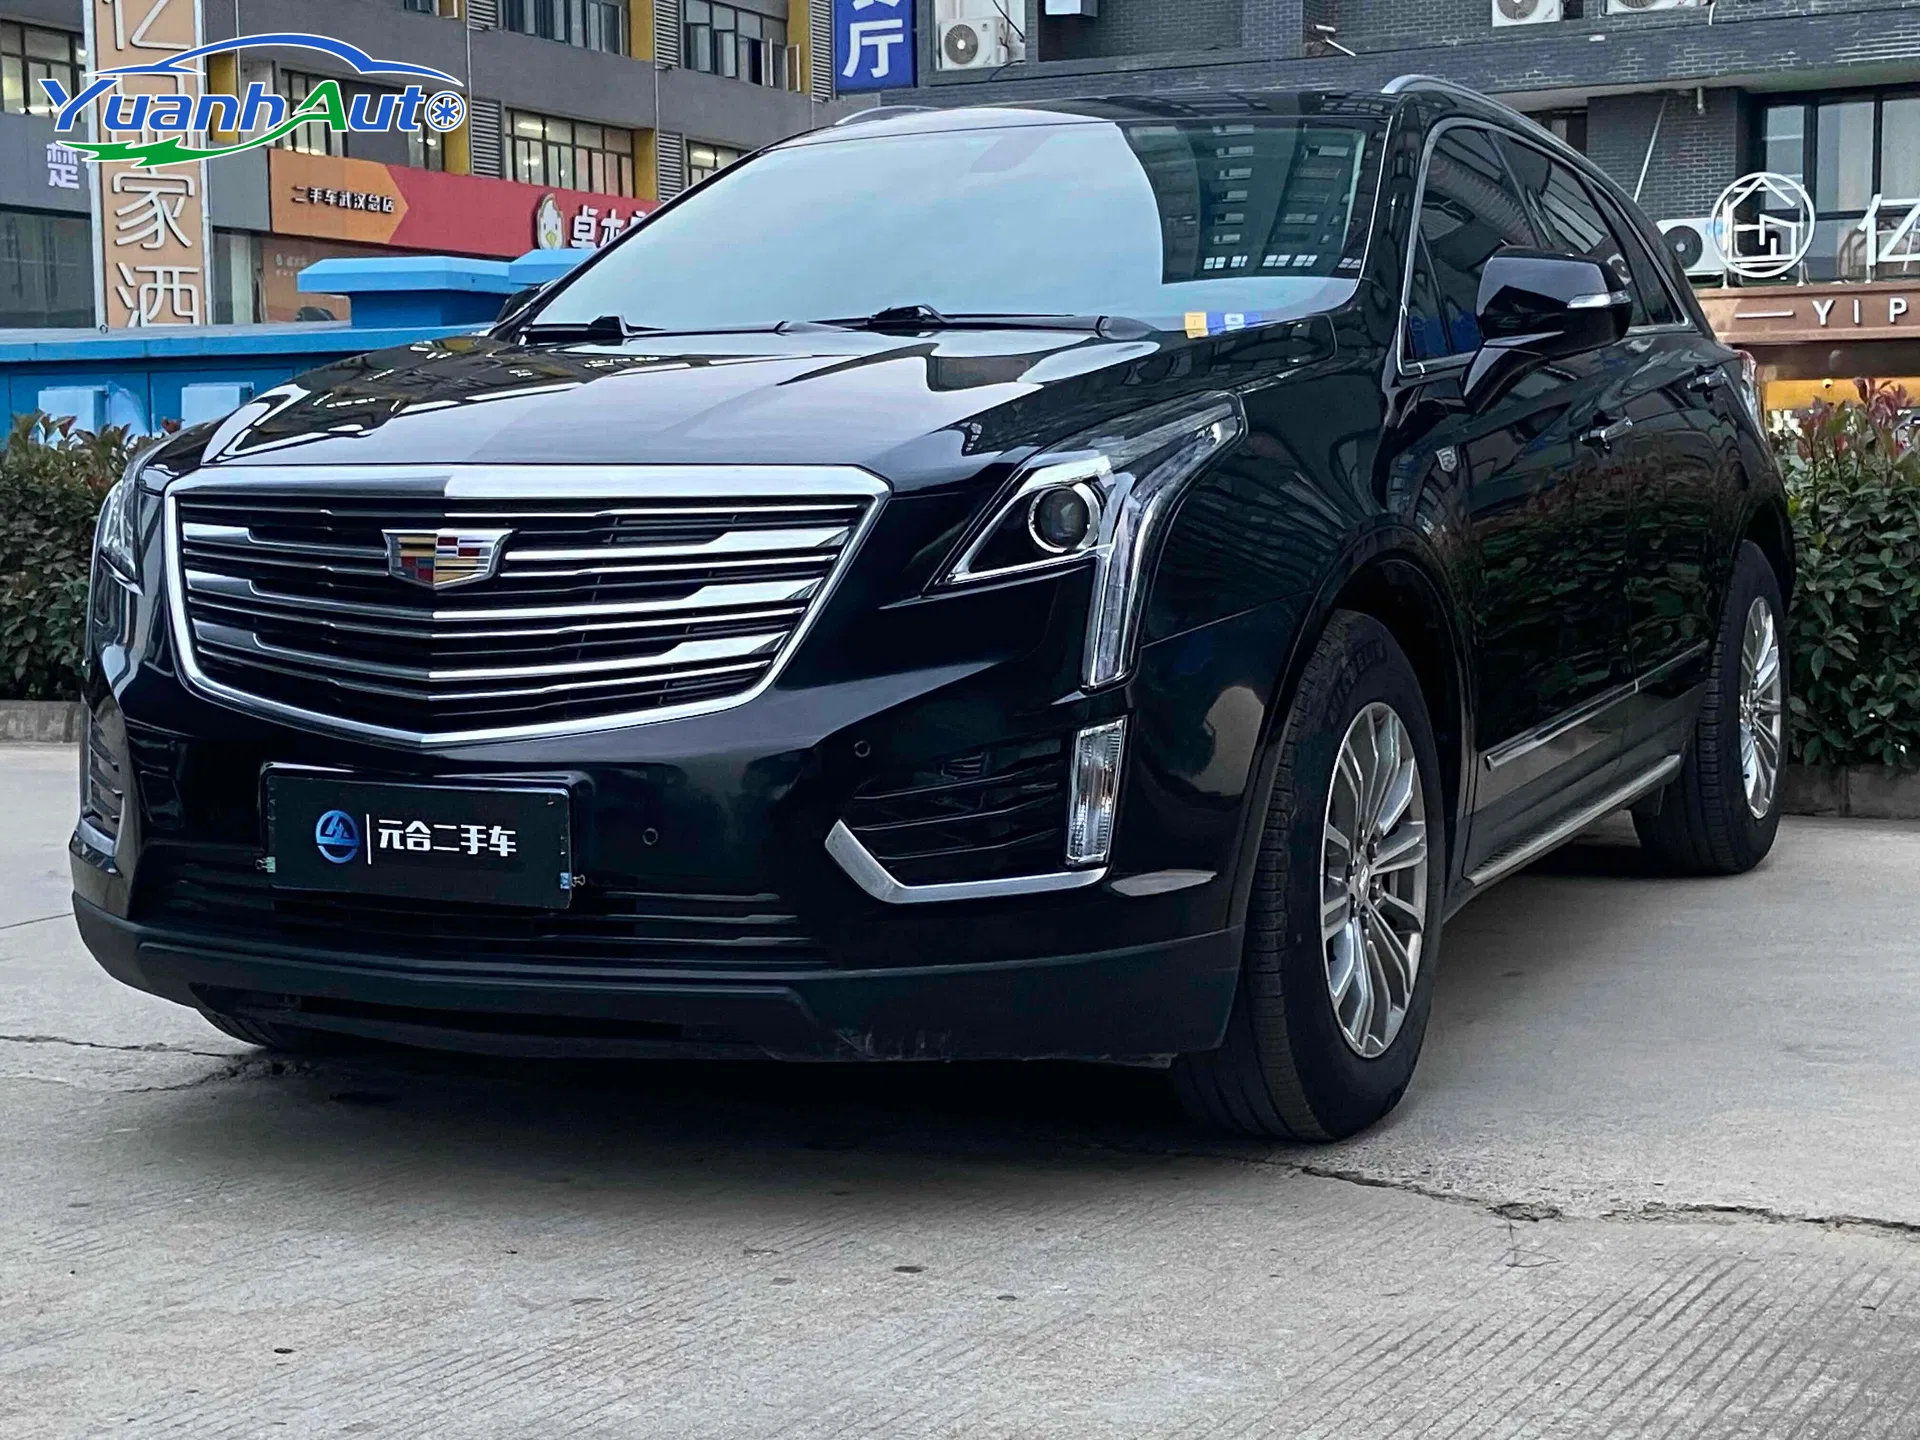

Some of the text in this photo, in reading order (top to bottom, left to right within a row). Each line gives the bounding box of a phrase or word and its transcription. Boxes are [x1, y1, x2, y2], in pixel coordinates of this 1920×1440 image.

[842, 0, 904, 78] 厅
[46, 142, 79, 189] 楚
[292, 185, 395, 213] 二手车武汉总店
[570, 204, 647, 249] 卓木
[378, 819, 517, 857] 元合二手车
